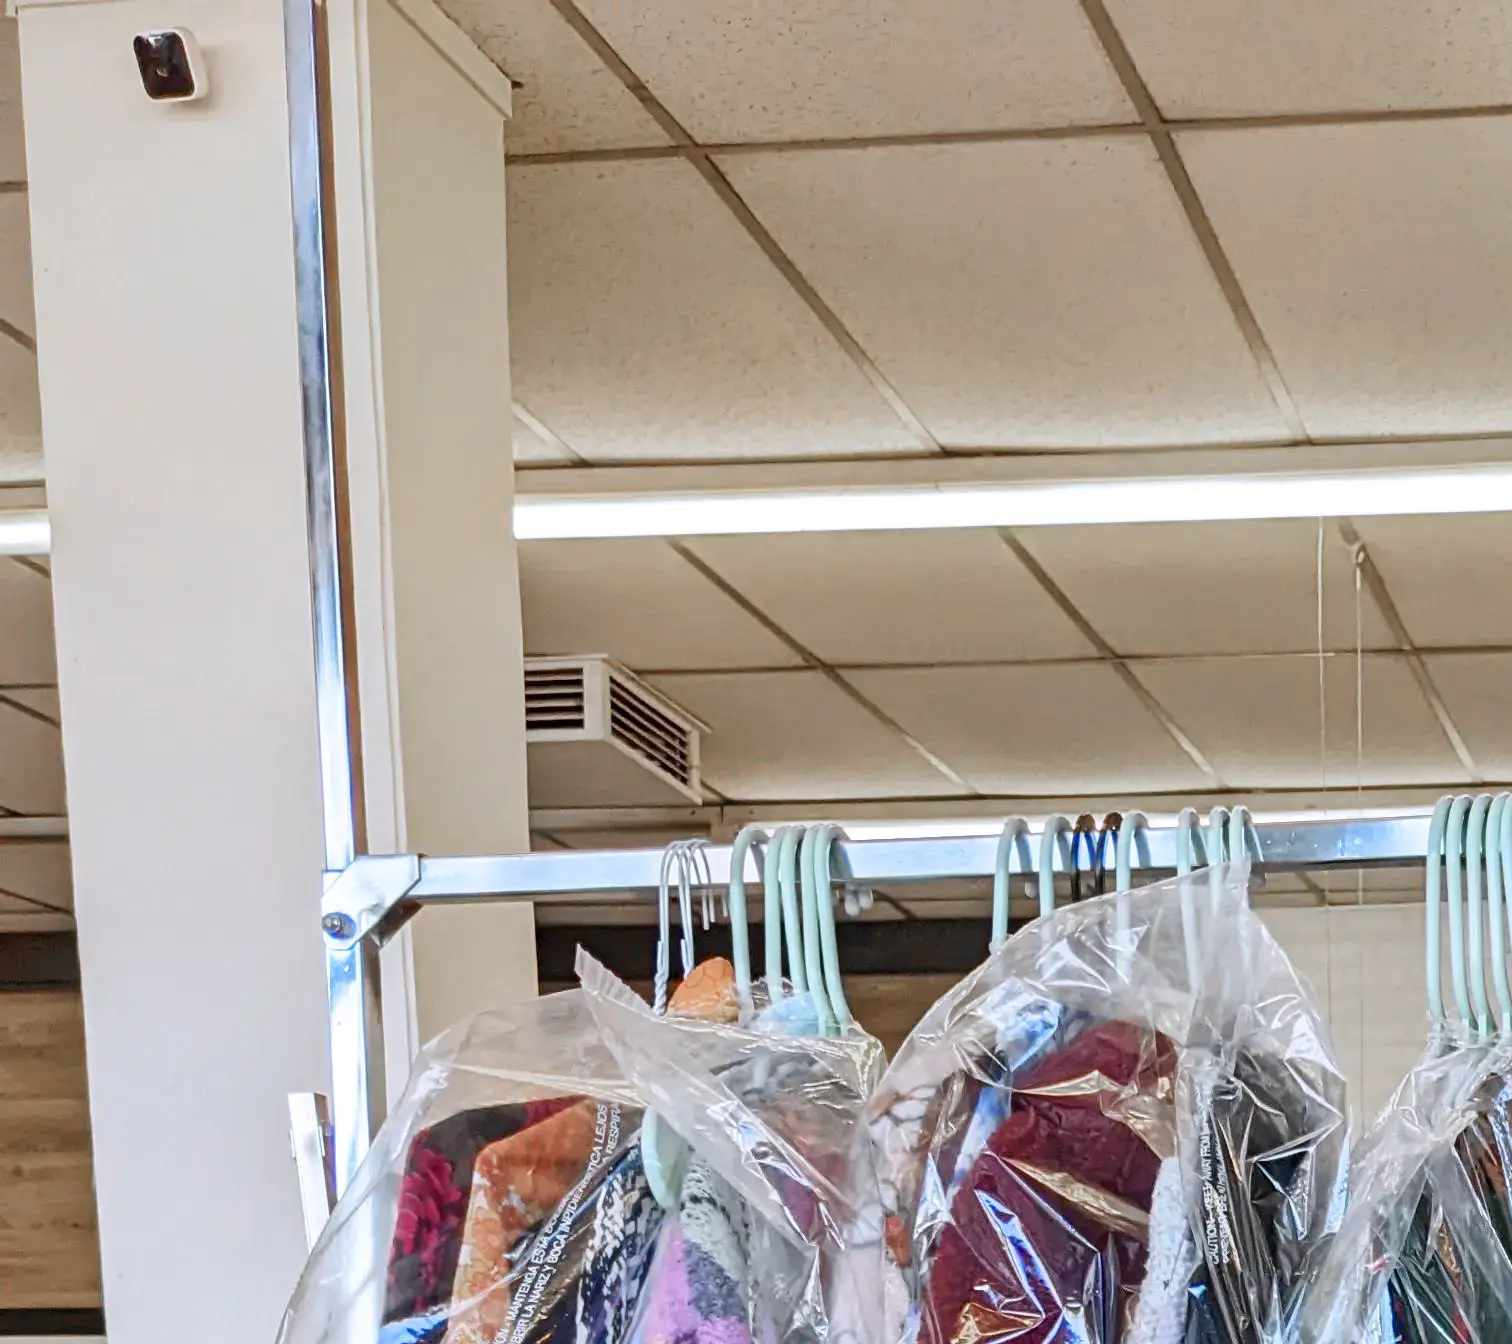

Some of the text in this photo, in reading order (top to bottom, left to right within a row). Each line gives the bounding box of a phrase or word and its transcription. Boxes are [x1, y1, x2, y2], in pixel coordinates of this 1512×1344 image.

[603, 1099, 621, 1154] RESPIRA
[1199, 1134, 1210, 1156] FROM
[505, 1262, 539, 1323] MANTENGA
[594, 1102, 607, 1144] LEJOS
[546, 1230, 567, 1266] BOCA
[541, 1263, 554, 1274] Y
[527, 1270, 551, 1305] NARIZ
[520, 1301, 536, 1319] LA
